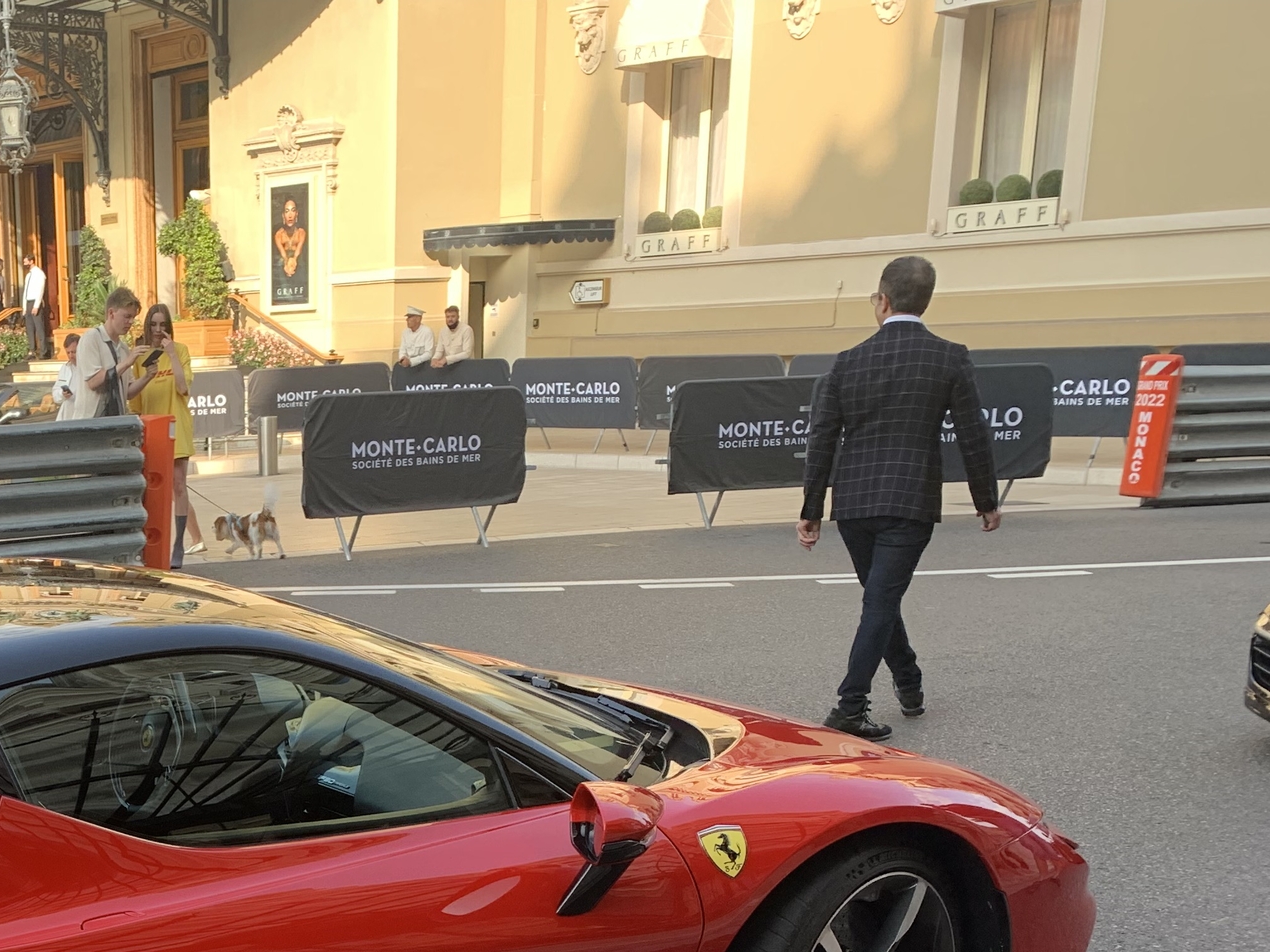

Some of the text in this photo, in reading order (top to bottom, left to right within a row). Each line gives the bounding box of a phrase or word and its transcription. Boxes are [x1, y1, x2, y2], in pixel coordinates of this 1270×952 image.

[617, 39, 690, 63] GRAFF
[955, 205, 1048, 228] GRAFF
[641, 234, 711, 253] GRAFF
[277, 286, 304, 296] GRAFF
[556, 396, 569, 404] DES
[571, 396, 592, 404] BAINS
[594, 396, 605, 404] DE
[1087, 398, 1102, 406] DE
[1105, 397, 1130, 406] MER
[1135, 393, 1166, 407] 2022
[994, 430, 1021, 441] MER
[718, 437, 807, 449] SOCIÉTÉ DES BAIN
[1128, 411, 1153, 484] MONACO
[352, 453, 481, 470] SOCIÉTÉ DES BAINS DE MER
